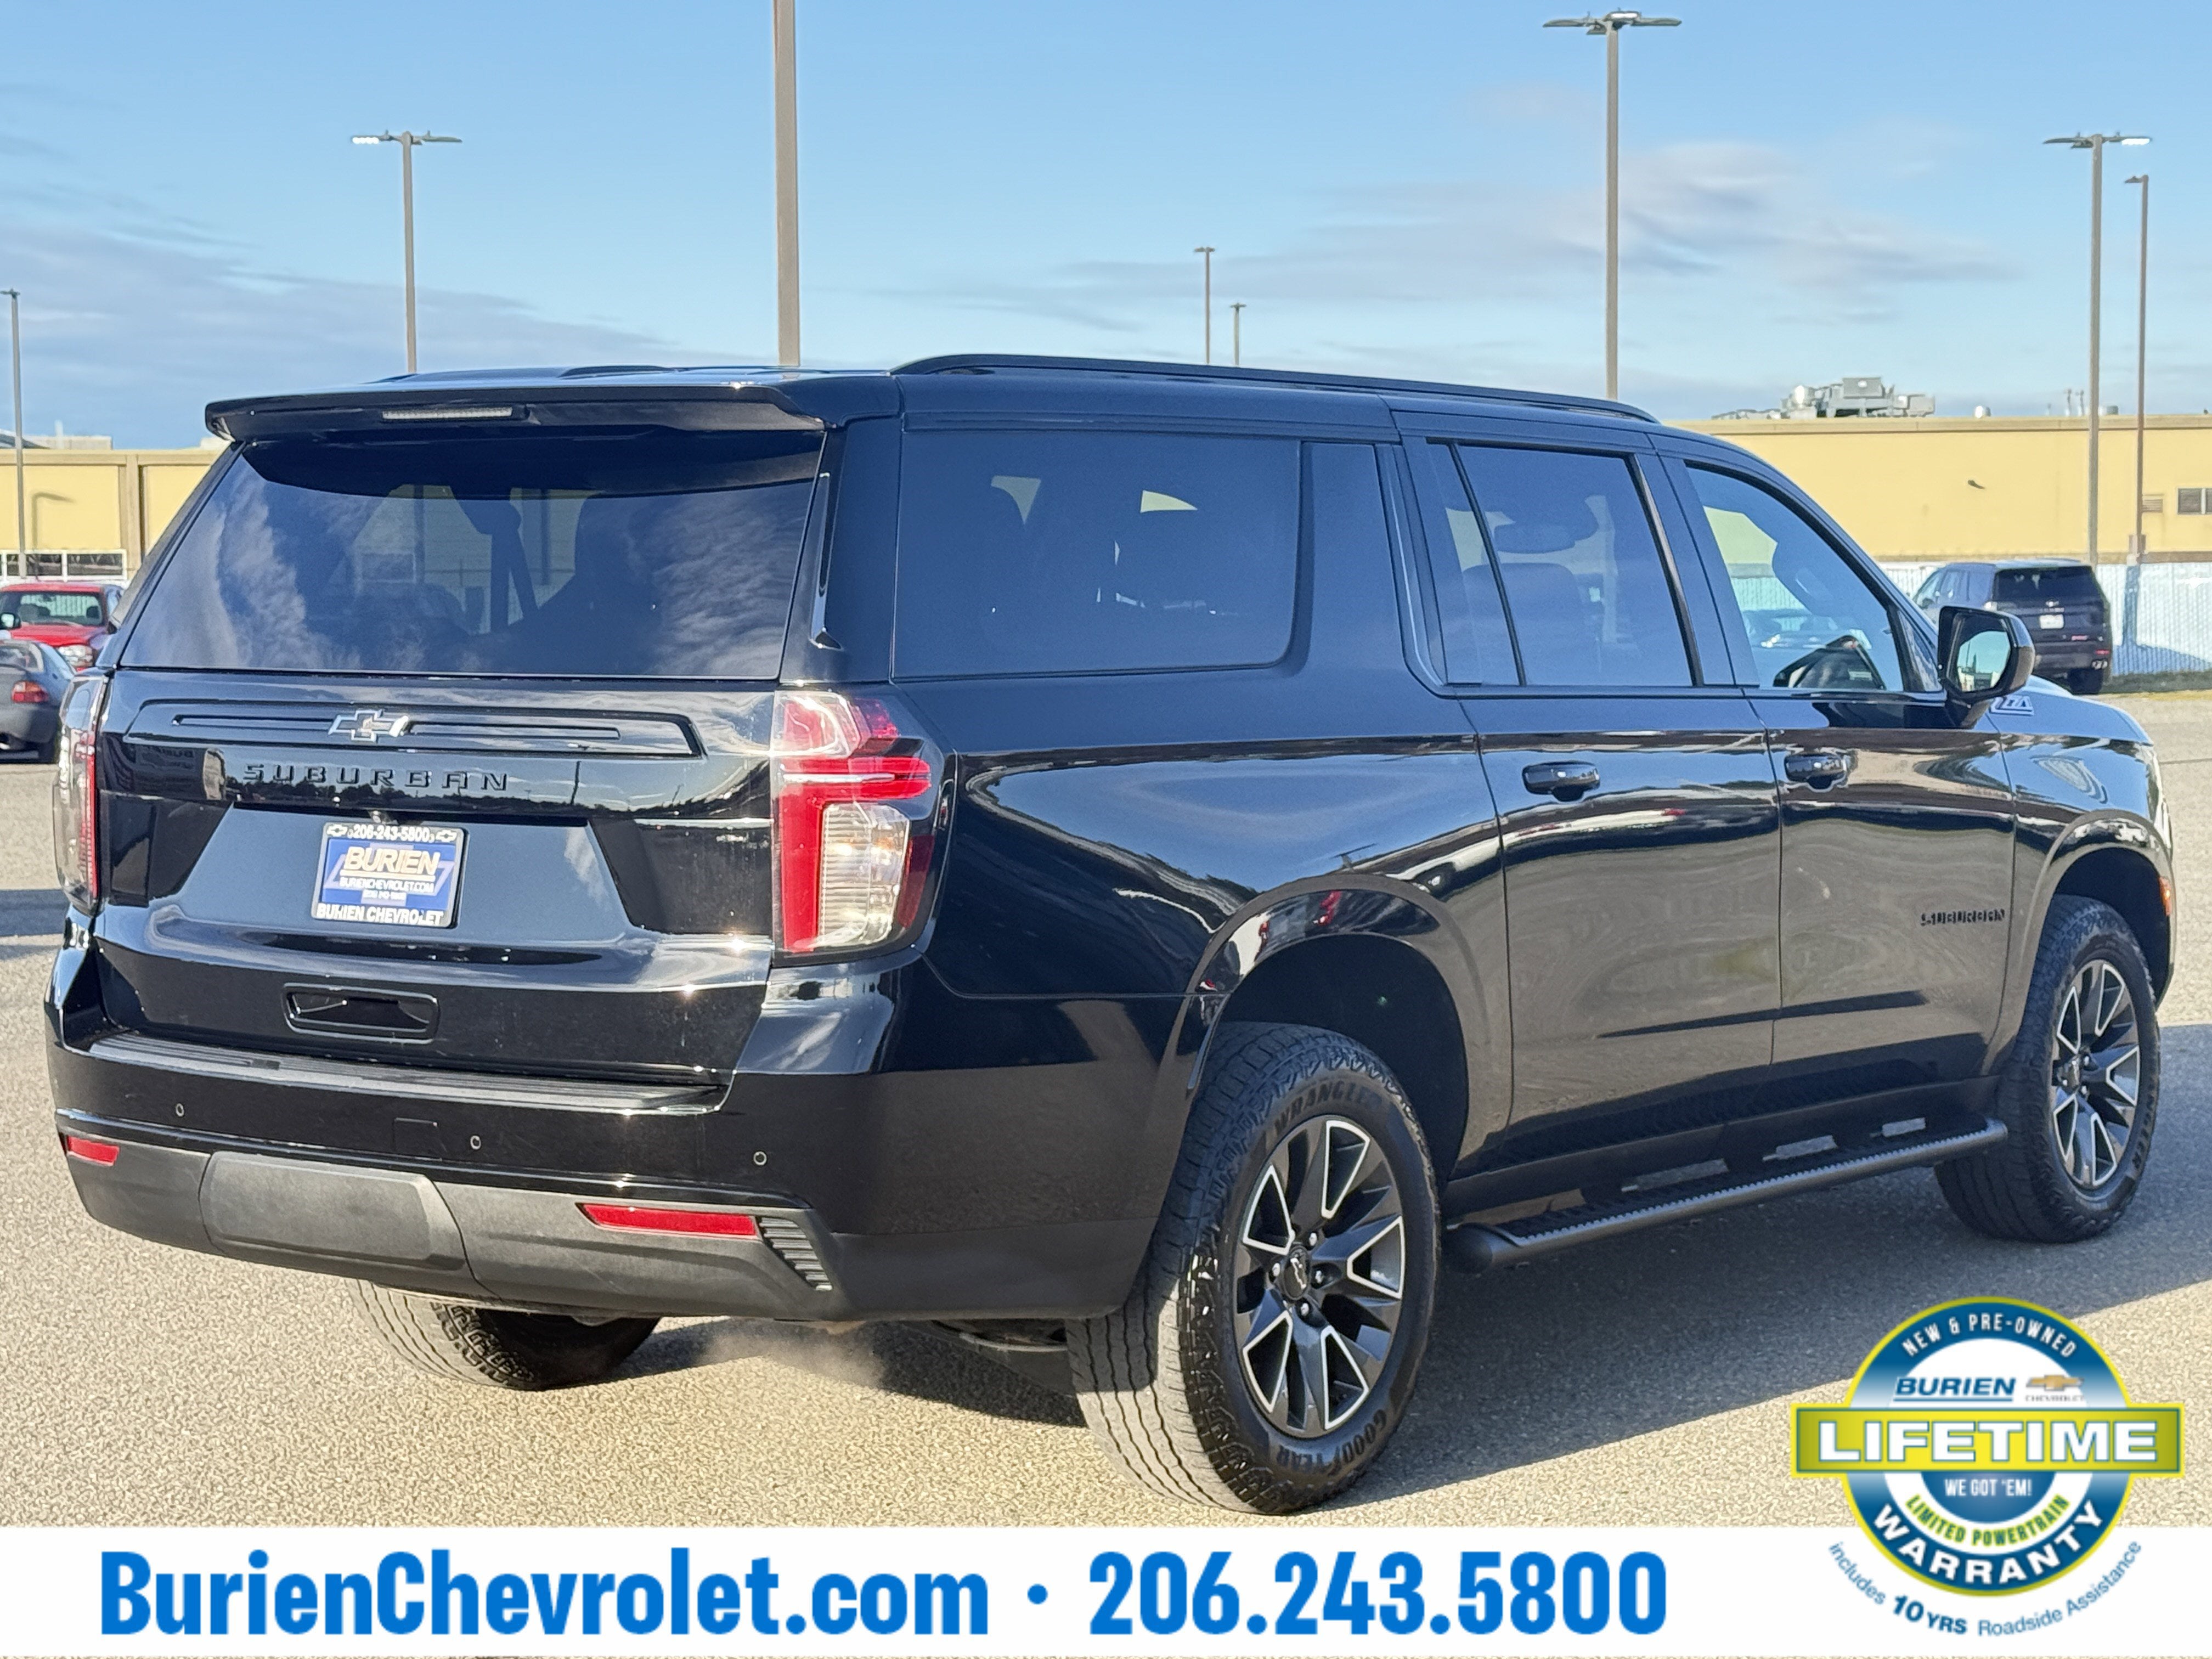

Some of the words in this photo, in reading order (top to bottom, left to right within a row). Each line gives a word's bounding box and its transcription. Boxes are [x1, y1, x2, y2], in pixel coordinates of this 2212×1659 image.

[243, 764, 507, 791] SUBURBAN
[354, 824, 430, 842] 206-243-5800
[344, 847, 440, 875] BURIEN
[1921, 909, 2005, 927] SUBURBAN
